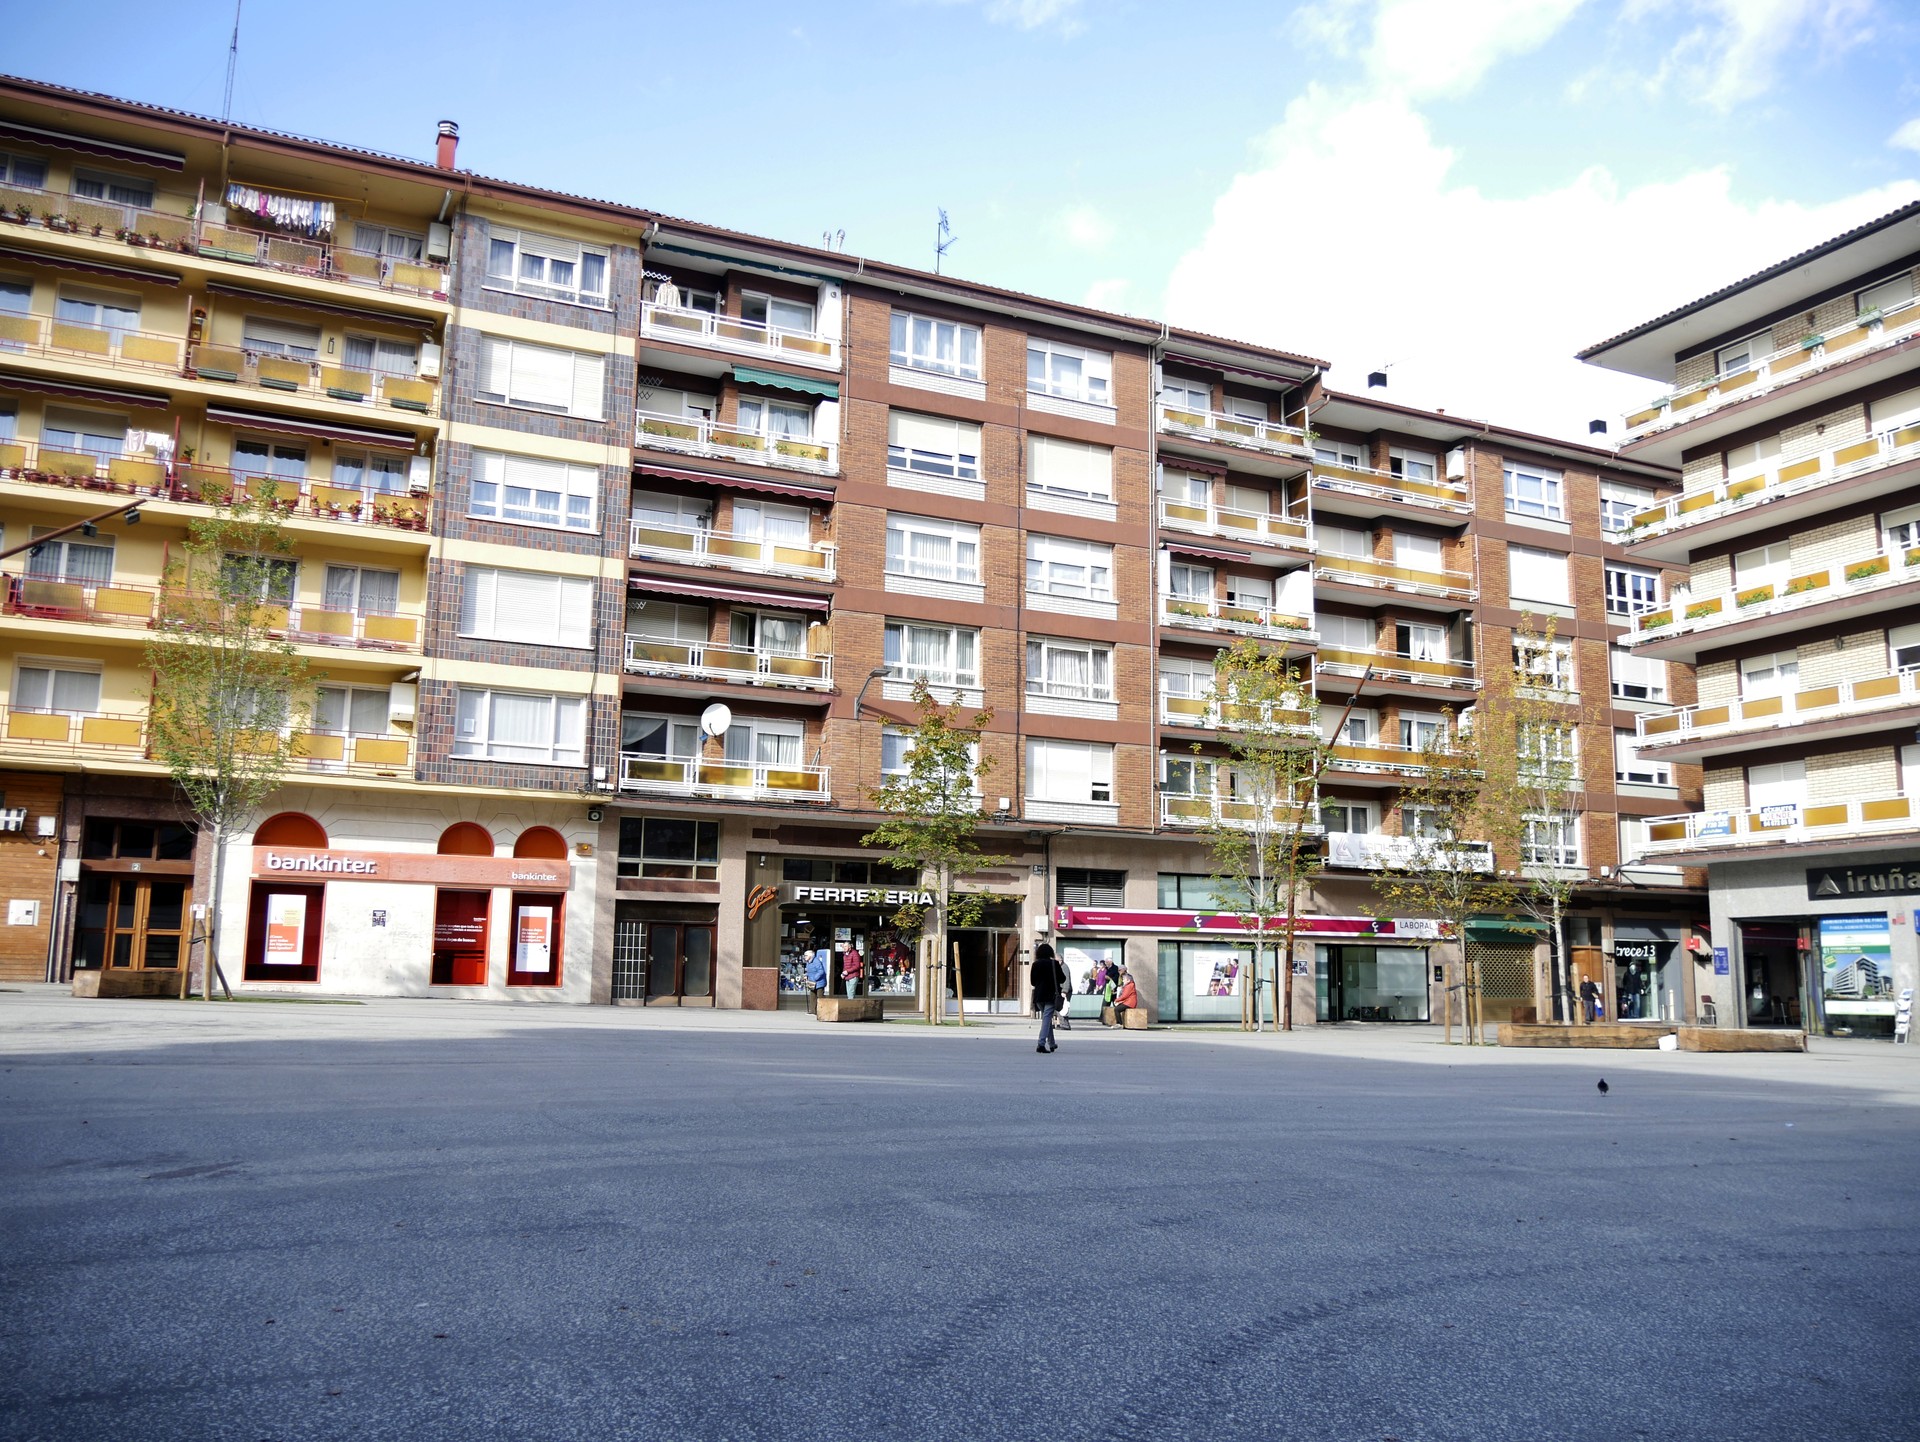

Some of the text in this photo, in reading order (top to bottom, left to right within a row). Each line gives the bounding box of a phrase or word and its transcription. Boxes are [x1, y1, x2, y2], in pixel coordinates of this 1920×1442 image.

[1766, 811, 1792, 820] VENDE
[1846, 867, 1920, 893] iruña
[794, 886, 934, 905] FERREERIA
[1399, 921, 1434, 930] LABORAL
[1616, 944, 1656, 957] trece13
